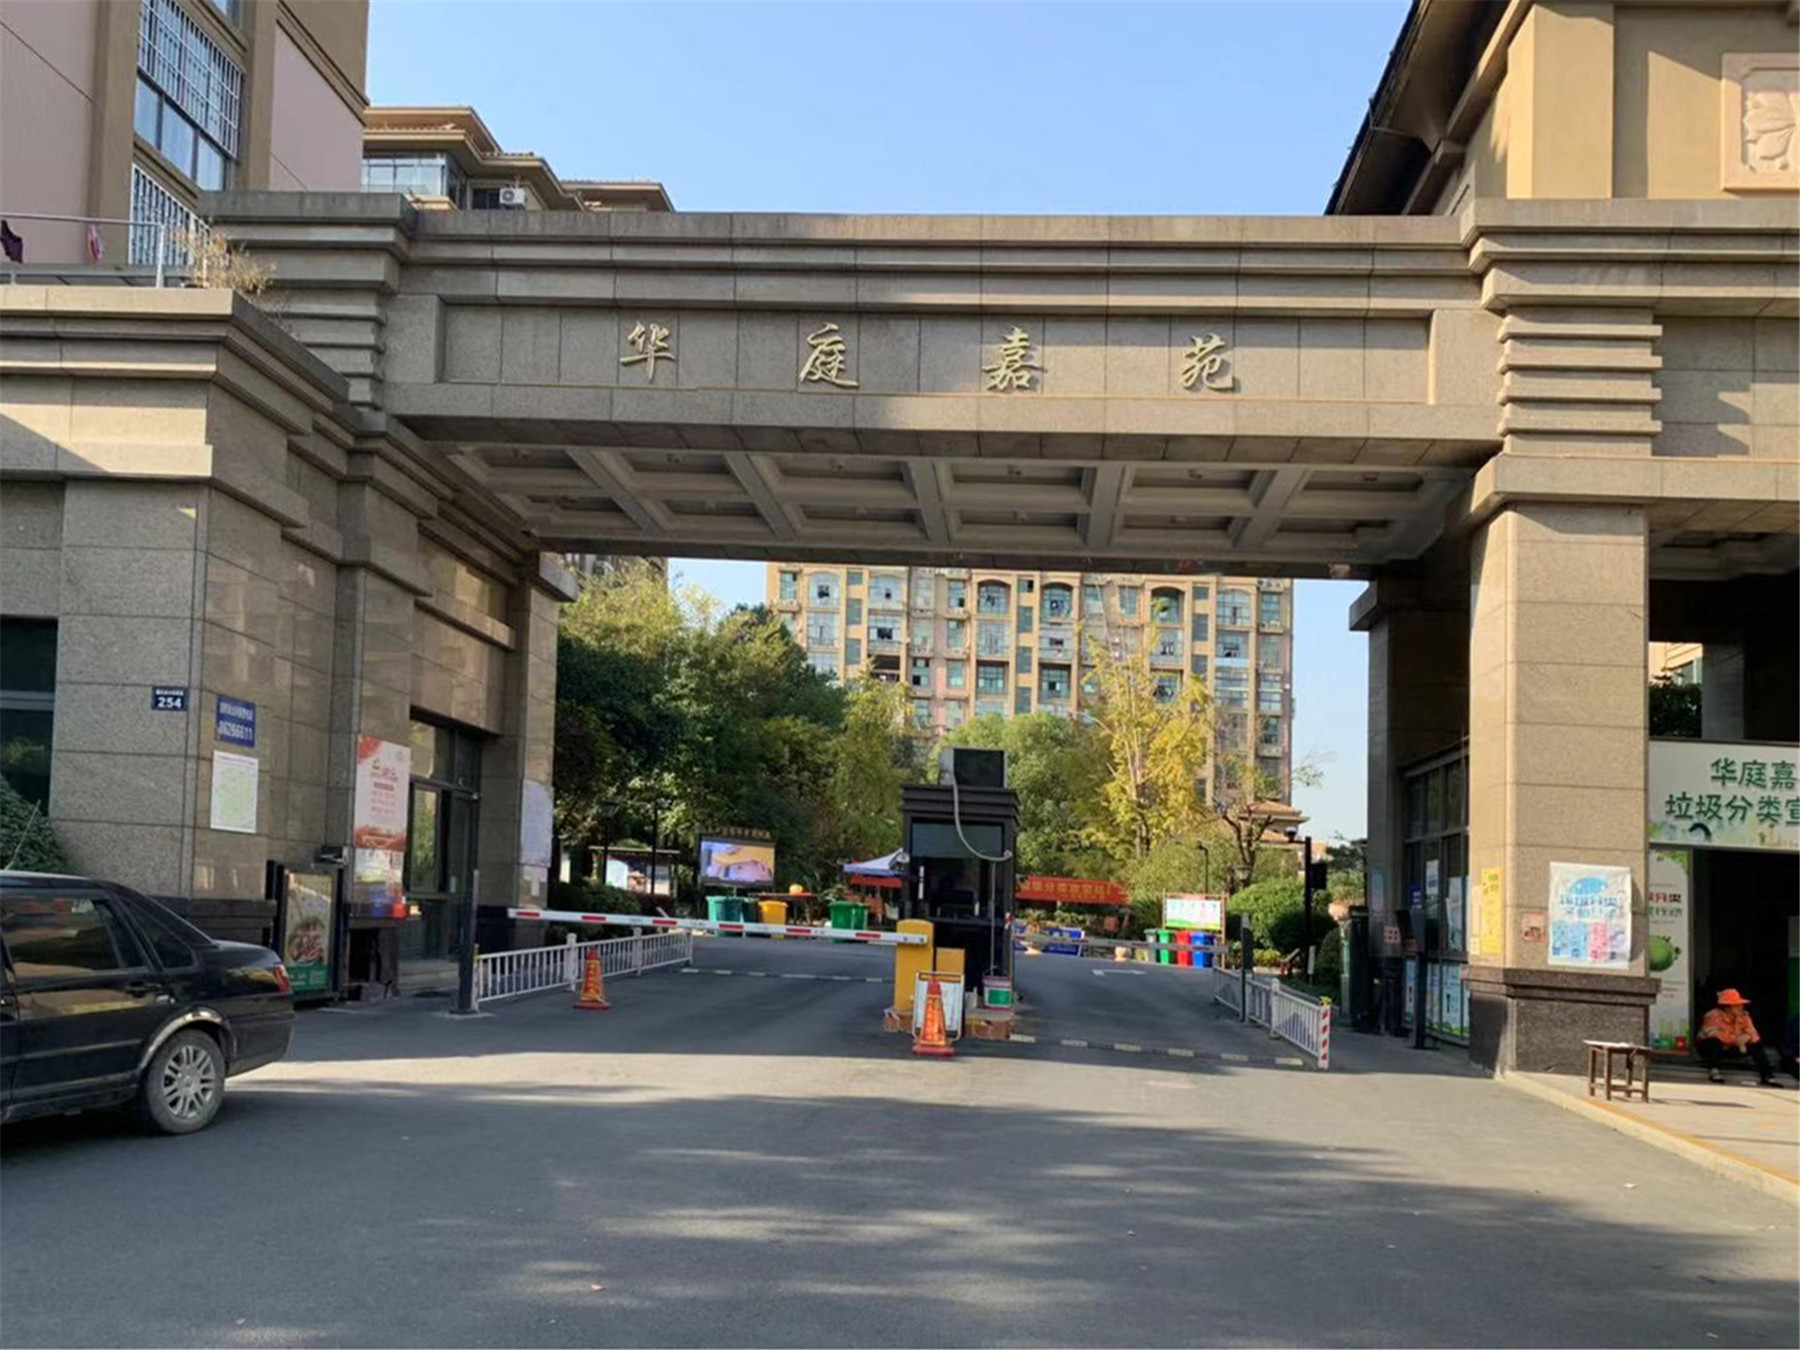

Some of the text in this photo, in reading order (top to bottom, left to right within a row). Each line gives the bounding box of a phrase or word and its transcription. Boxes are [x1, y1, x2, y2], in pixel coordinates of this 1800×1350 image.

[620, 320, 1236, 391] 华庭嘉苑
[157, 696, 182, 709] 254
[1710, 757, 1797, 790] 华庭嘉
